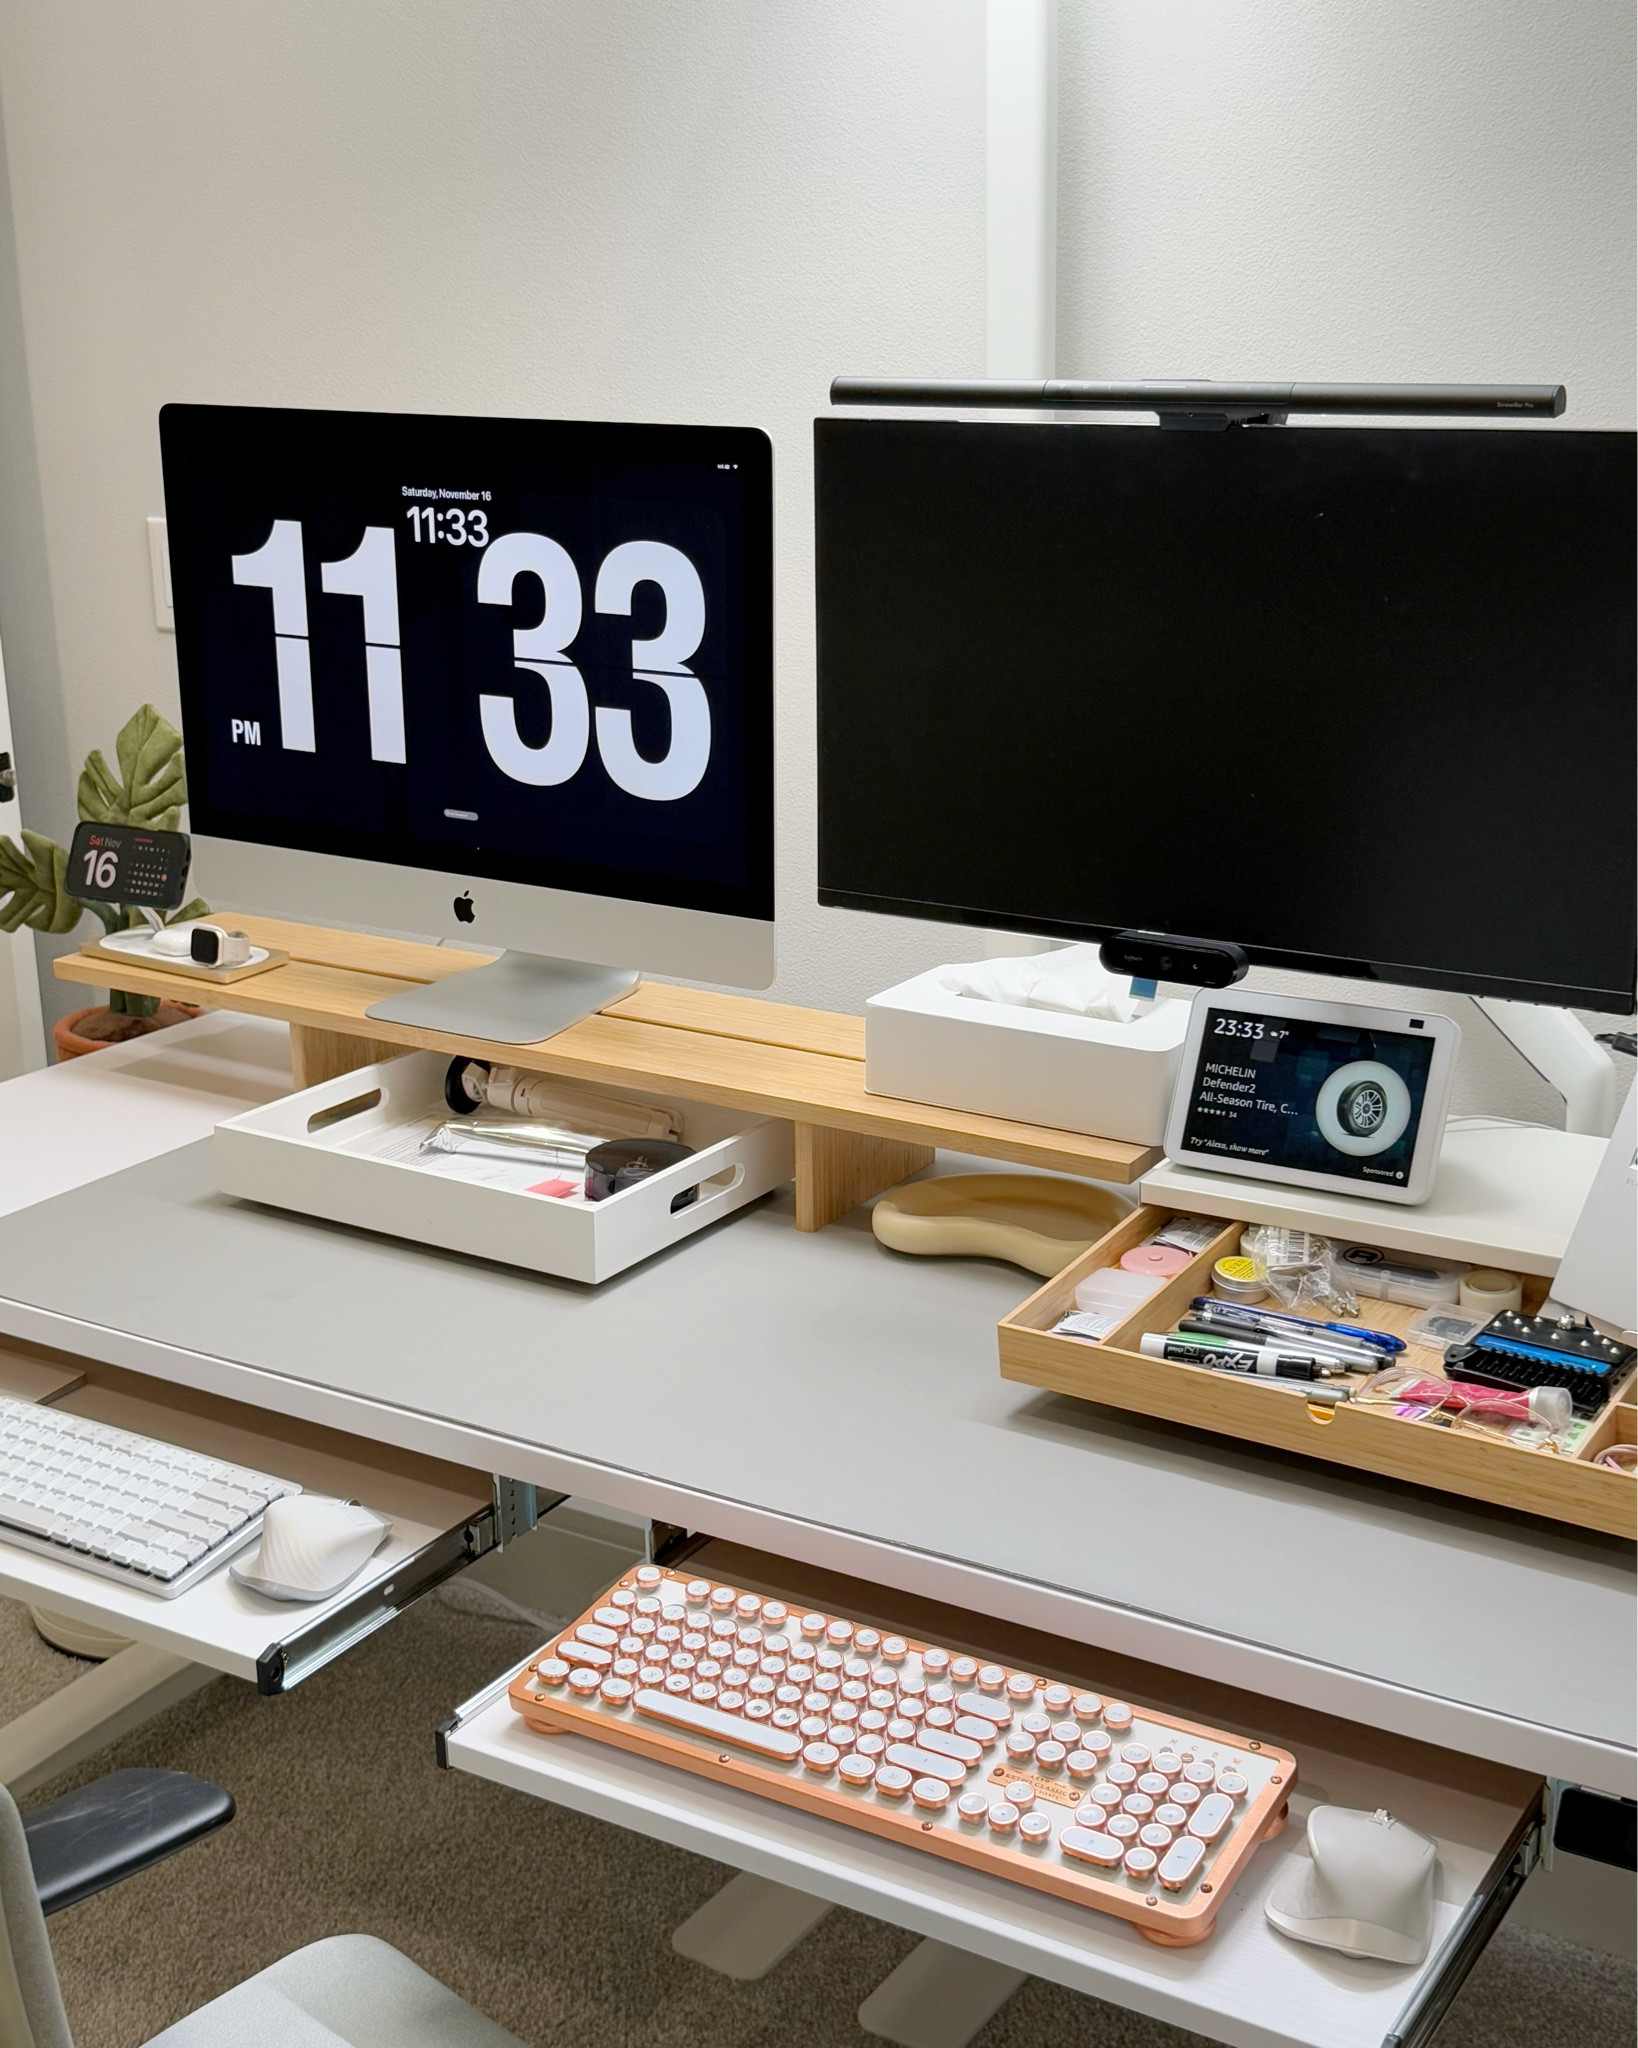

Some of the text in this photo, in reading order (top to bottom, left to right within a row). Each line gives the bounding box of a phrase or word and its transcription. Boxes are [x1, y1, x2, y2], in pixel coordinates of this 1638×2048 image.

[401, 486, 492, 501] Saturday, November 16
[406, 505, 490, 548] 11:33
[231, 519, 712, 802] 11 33
[231, 719, 261, 747] PM
[89, 835, 104, 847] Sat
[105, 837, 122, 849] Nov
[83, 849, 119, 889] 16
[1213, 1017, 1265, 1040] 23:33
[1205, 1062, 1256, 1079] MICHELIN
[1202, 1077, 1256, 1094] Defender2
[1199, 1091, 1253, 1108] All-Season
[1255, 1099, 1277, 1113] Tire,
[1190, 1136, 1203, 1146] Try
[1229, 1142, 1248, 1152] show
[1362, 1166, 1395, 1177] Sponsored
[1203, 1352, 1254, 1372] EXPO
[1034, 1782, 1069, 1797] CLASSIC
